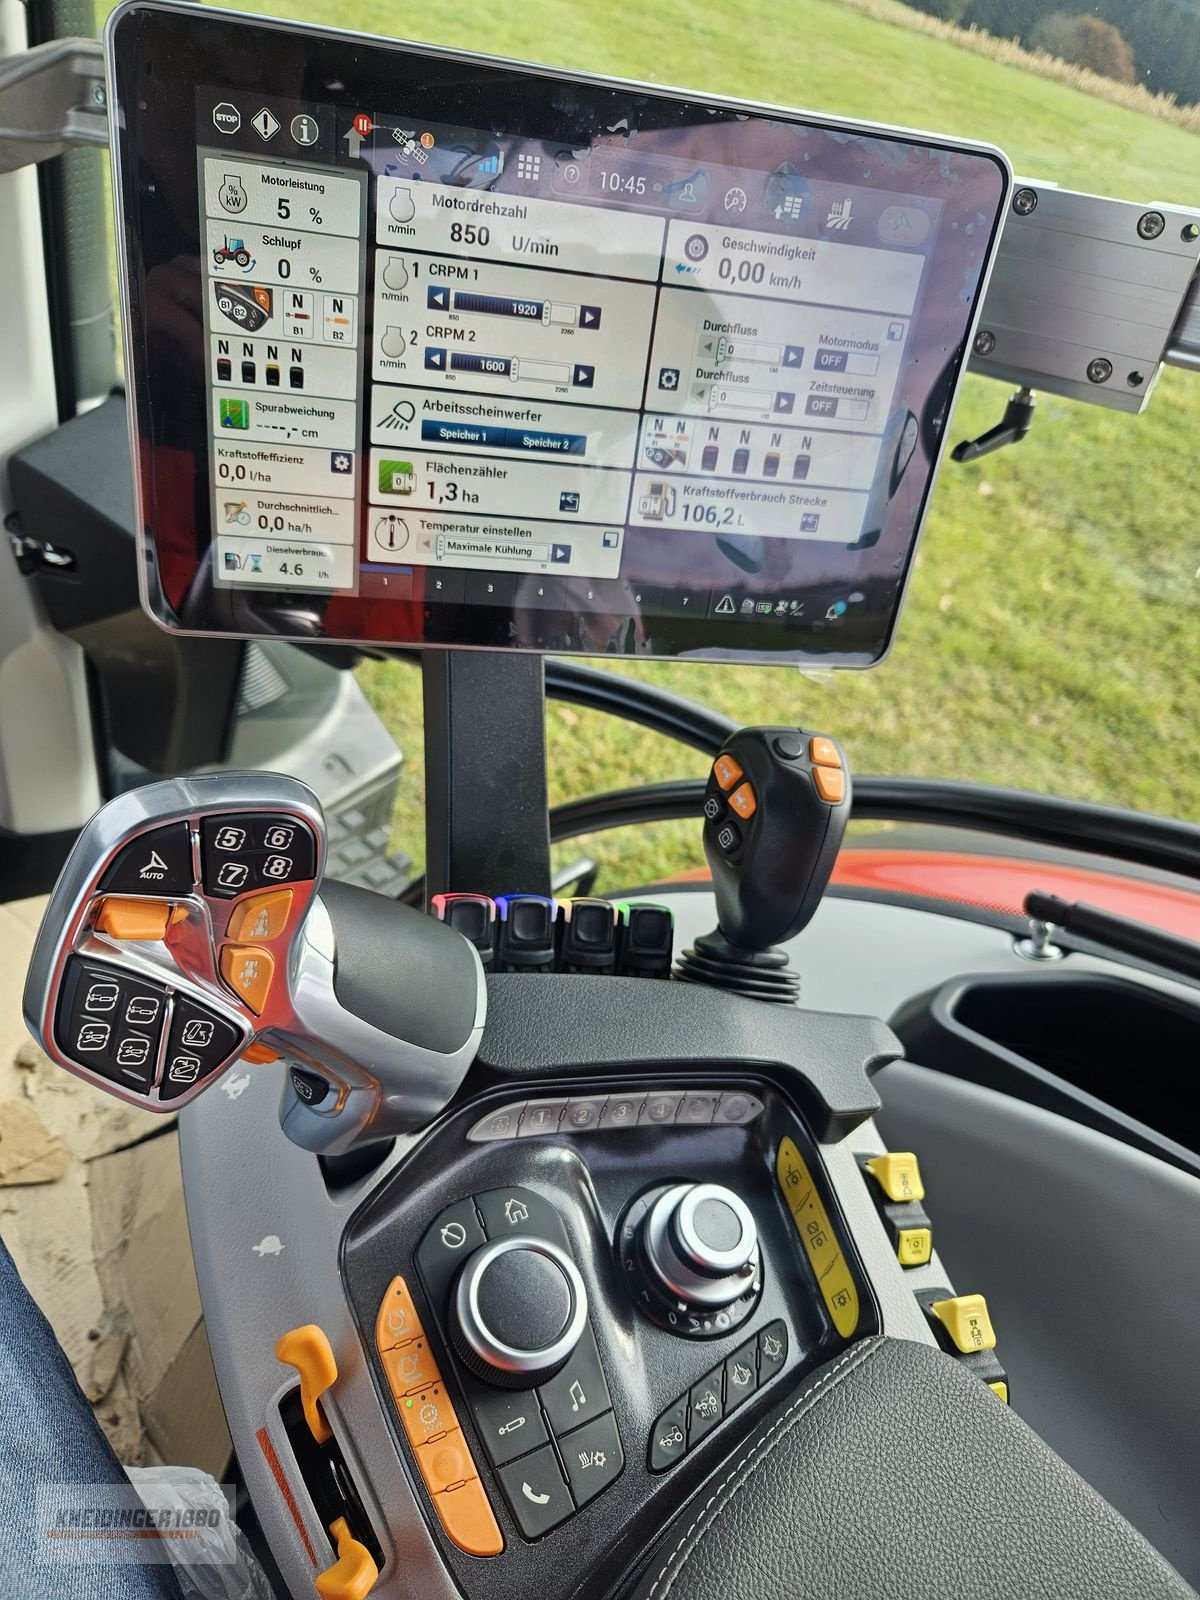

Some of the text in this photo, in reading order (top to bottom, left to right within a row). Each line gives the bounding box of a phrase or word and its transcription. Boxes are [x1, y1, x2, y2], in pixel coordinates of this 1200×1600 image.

[216, 114, 238, 123] STOP
[229, 186, 238, 196] %
[261, 174, 325, 194] Motorleistung
[600, 172, 646, 195] 10:45
[226, 196, 241, 207] kW
[432, 194, 528, 220] Motordrehzahl
[278, 199, 322, 224] 5 %
[388, 224, 416, 236] n/min
[262, 234, 302, 250] Schlupf
[450, 222, 559, 257] 850 U/min
[722, 236, 816, 261] Geschwindigkeit
[278, 259, 322, 283] 0 %
[412, 262, 420, 278] 1
[429, 263, 479, 281] CRPM 1
[718, 258, 802, 289] 0,00 km/h
[221, 300, 231, 309] B1
[293, 294, 303, 309] N
[382, 291, 409, 303] n/min
[234, 308, 245, 317] B2
[333, 299, 343, 313] N
[512, 302, 537, 316] 1920
[293, 326, 304, 336] B1
[333, 332, 344, 340] B2
[426, 325, 476, 342] CRPM 2
[703, 320, 759, 337] Durchfluss
[410, 330, 418, 347] 2
[818, 334, 879, 352] Motormodus
[218, 340, 302, 363] N N N N
[728, 345, 734, 355] 0
[380, 358, 407, 371] n/min
[480, 360, 505, 372] 1600
[820, 354, 842, 367] OFF
[696, 368, 750, 384] Durchfluss
[720, 392, 727, 401] 0
[808, 382, 875, 398] Zeitsteuerung
[255, 402, 336, 420] Spurabweichung
[422, 400, 543, 423] Arbeitsscheinwerfer
[812, 400, 832, 412] OFF
[302, 429, 319, 439] cm
[654, 419, 686, 434] N N
[440, 429, 487, 442] Speicher 1
[708, 427, 812, 450] N N N N
[524, 437, 569, 451] Speicher 2
[217, 448, 305, 465] Kraftstoffeffizienz
[219, 463, 272, 483] 0,0 l/ha
[426, 462, 508, 480] Flächenzähler
[427, 481, 480, 505] 1,3 ha
[683, 485, 828, 508] Kraftstoffverbrauch Strecke
[257, 500, 340, 516] Durchschnittlich...
[258, 515, 312, 533] 0,0 ha/h
[682, 504, 735, 529] 106,2
[420, 520, 532, 538] Temperatur einstellen
[447, 540, 533, 559] Maximale Kühlung
[280, 562, 329, 580] 4.6 l/h
[384, 577, 388, 586] 1
[436, 581, 443, 589] 2
[488, 585, 494, 593] 3
[538, 588, 544, 596] 4
[588, 592, 594, 600] 5
[684, 598, 689, 606] 7
[222, 831, 287, 847] 5 6
[140, 872, 164, 881] AUTO
[226, 860, 286, 883] 7 8
[538, 1104, 665, 1125] 1 2 3 4
[626, 1260, 635, 1271] 2
[669, 1312, 677, 1325] 0
[702, 1405, 718, 1418] AUTO
